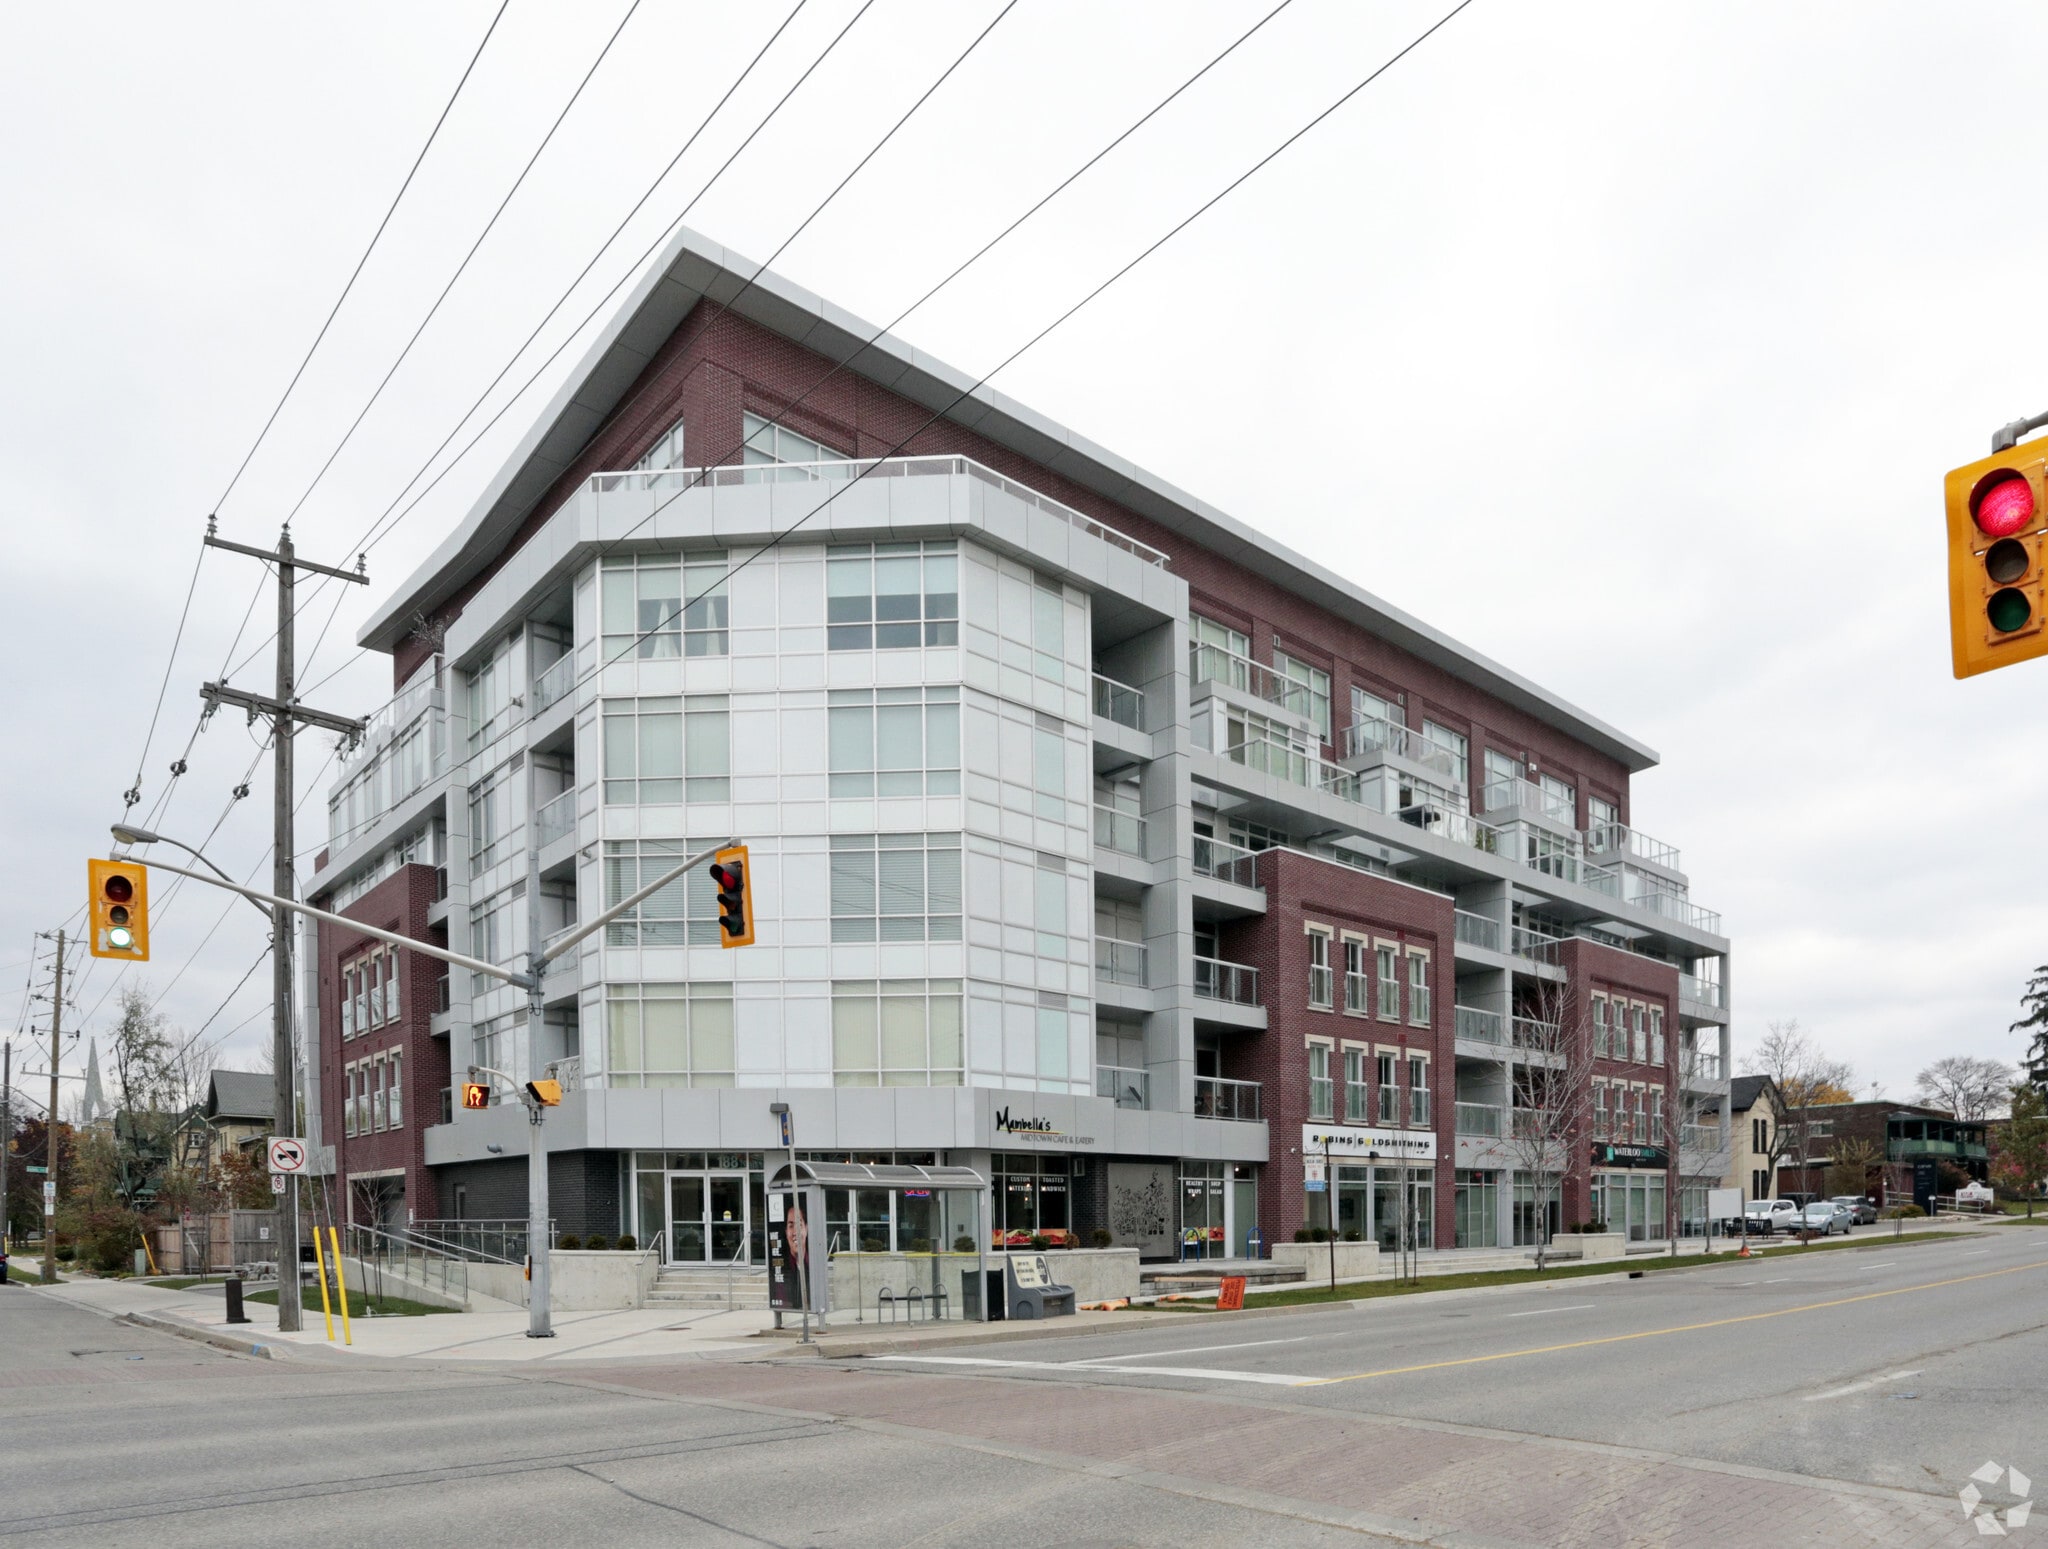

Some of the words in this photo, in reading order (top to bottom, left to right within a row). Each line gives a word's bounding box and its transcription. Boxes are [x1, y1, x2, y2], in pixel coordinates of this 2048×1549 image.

[996, 1105, 1051, 1134] Mambella's
[1020, 1134, 1053, 1143] MIDTOWN
[1075, 1136, 1095, 1145] EATERY
[1312, 1134, 1353, 1145] ROBINS
[1357, 1137, 1430, 1149] GOLDSMITHING
[1614, 1147, 1641, 1157] WATERLOO
[718, 1155, 738, 1169] 188
